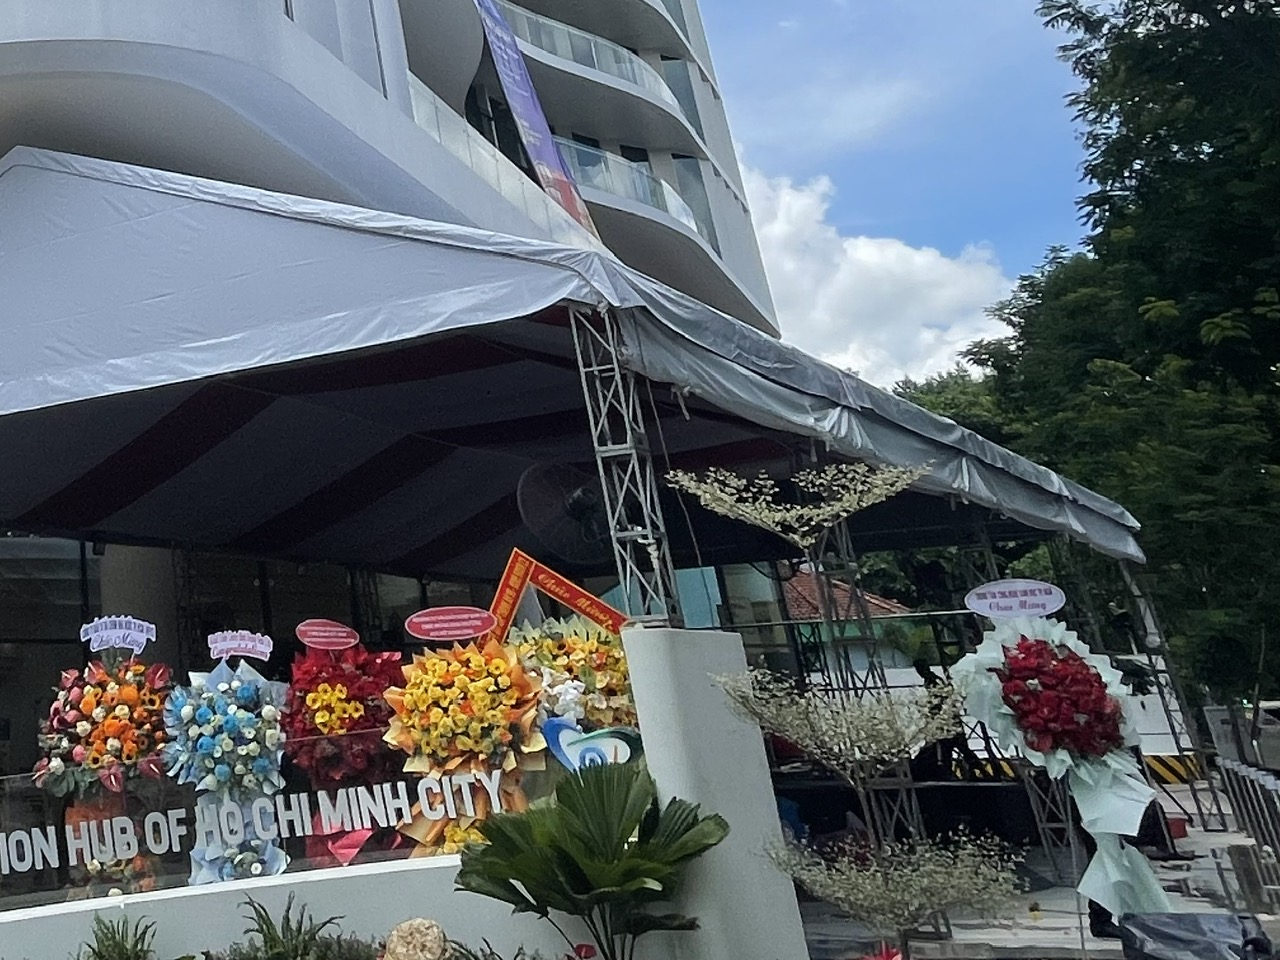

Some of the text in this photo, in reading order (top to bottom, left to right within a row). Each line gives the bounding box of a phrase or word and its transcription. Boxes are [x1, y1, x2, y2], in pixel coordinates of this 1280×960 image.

[66, 815, 140, 867] HUB
[145, 807, 188, 855] OF
[251, 792, 313, 841] CHI
[317, 780, 413, 836] MINH
[418, 769, 503, 821] CITY
